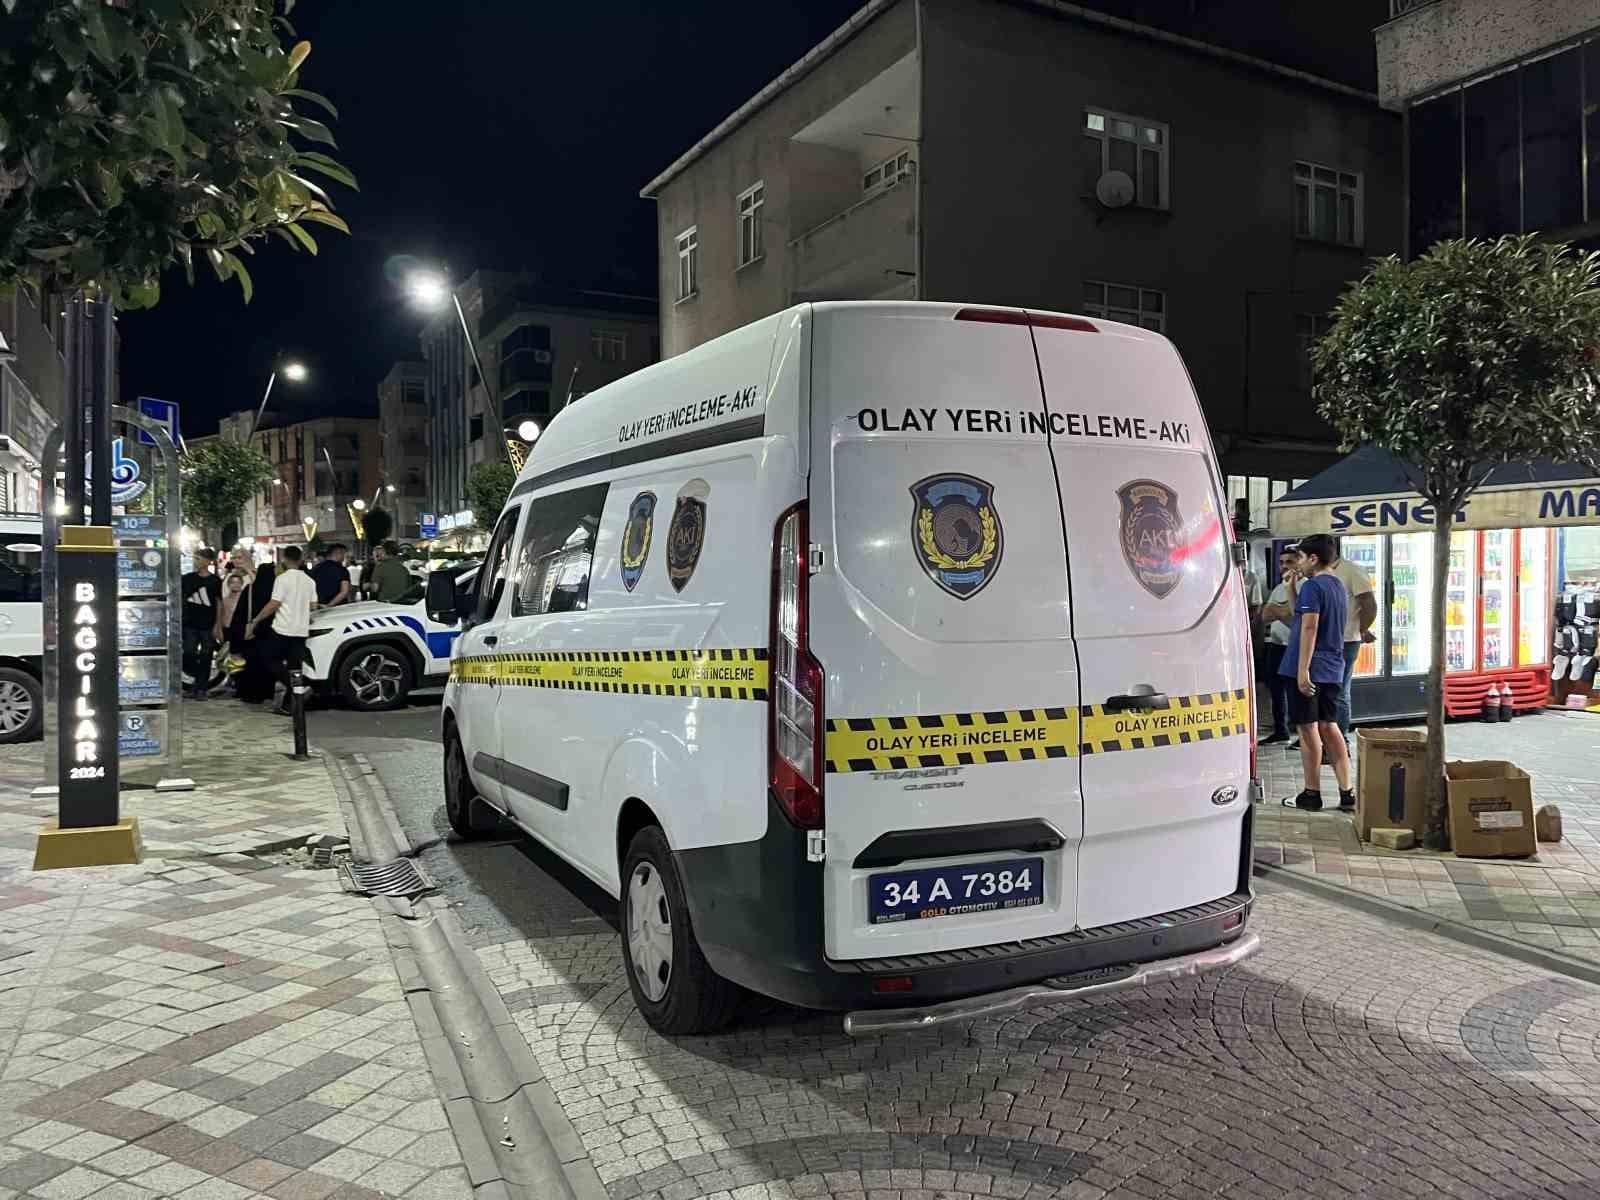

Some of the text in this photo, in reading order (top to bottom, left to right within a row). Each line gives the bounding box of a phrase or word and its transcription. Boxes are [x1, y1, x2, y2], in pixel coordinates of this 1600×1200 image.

[858, 408, 937, 431] OLAY
[619, 420, 643, 442] OLAY
[1331, 501, 1466, 533] ŞENE
[672, 667, 690, 679] OLAY
[1115, 718, 1149, 733] OLAY
[866, 735, 913, 751] OLAY
[70, 766, 105, 779] 2024
[884, 868, 1032, 907] 34 A 7384
[920, 908, 947, 919] GOLD
